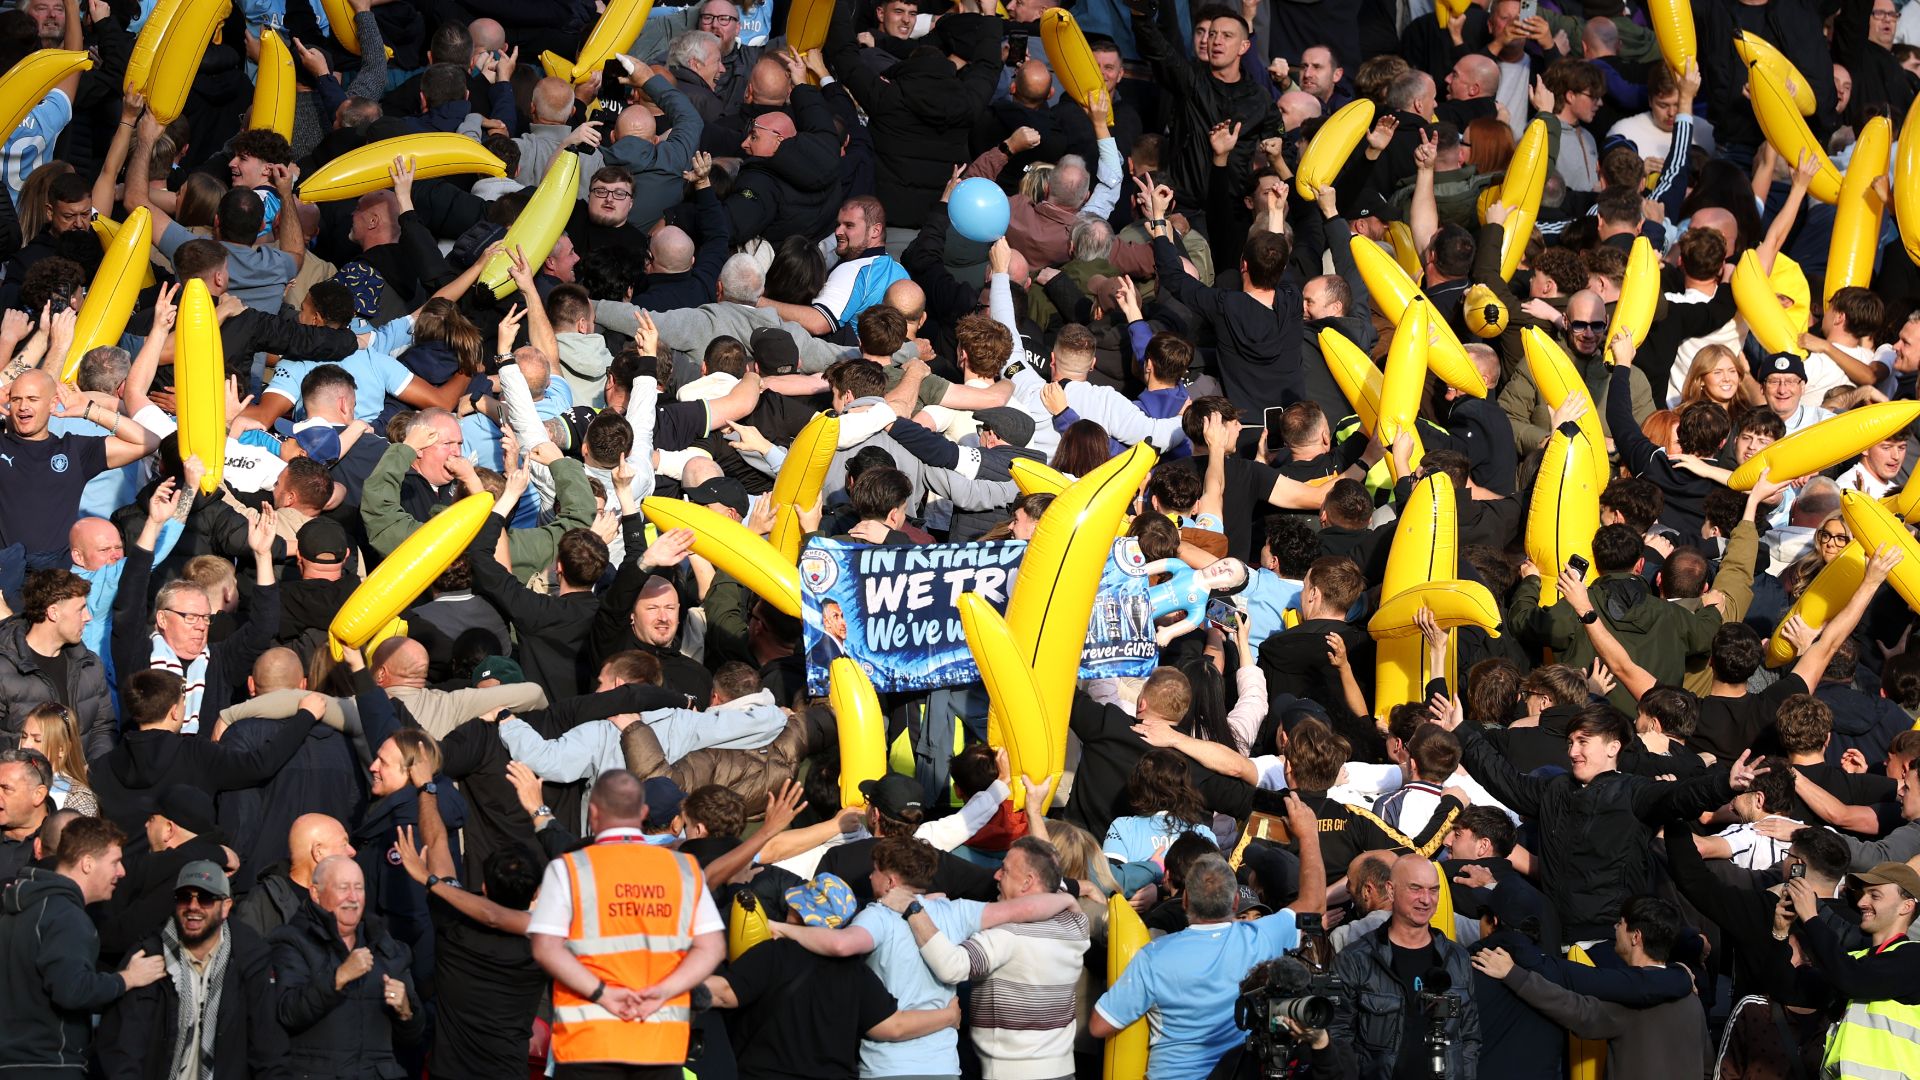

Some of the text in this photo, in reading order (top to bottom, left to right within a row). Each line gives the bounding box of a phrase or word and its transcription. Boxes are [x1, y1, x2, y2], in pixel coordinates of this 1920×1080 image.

[0, 135, 46, 192] 0
[860, 539, 1027, 574] IN KHALD
[865, 571, 936, 614] WE
[866, 612, 942, 651] We've
[608, 901, 672, 918] STEWARD
[615, 883, 665, 899] CROWD
